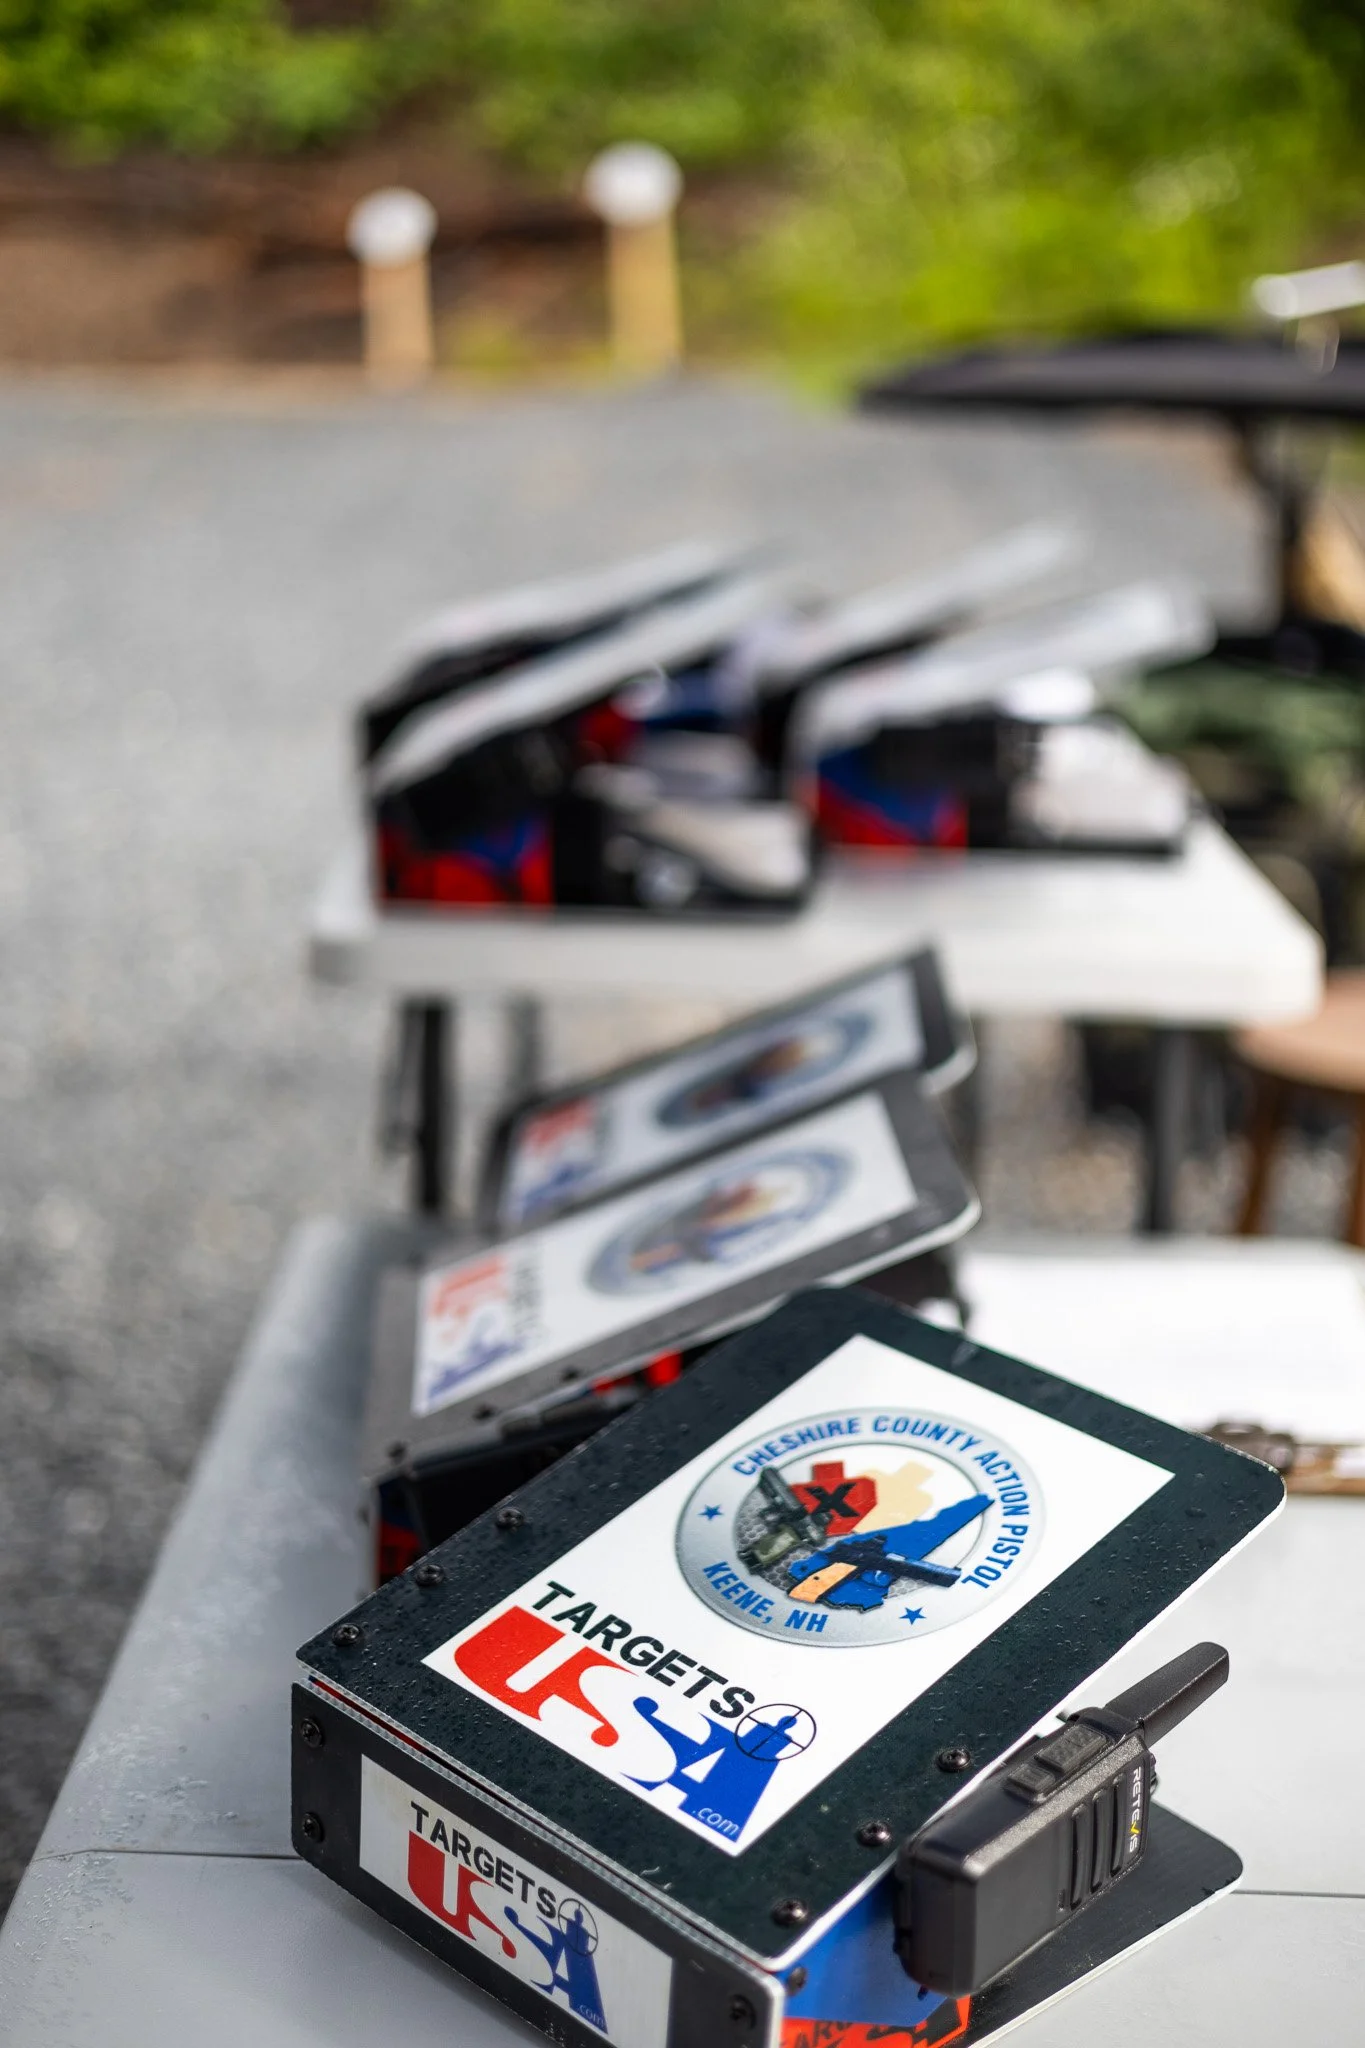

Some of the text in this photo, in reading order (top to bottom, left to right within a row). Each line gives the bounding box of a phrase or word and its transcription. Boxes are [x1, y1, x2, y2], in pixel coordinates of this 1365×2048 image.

[732, 1415, 1031, 1590] CHESHIRE COUNTY ACTION PISTOL
[532, 1581, 756, 1719] TARGETS
[702, 1560, 829, 1634] KEENE, NH
[454, 1605, 797, 1843] USA
[410, 1801, 557, 1919] TARGETS
[692, 1807, 740, 1836] .com
[1129, 1766, 1142, 1853] RETEVIS
[407, 1830, 608, 2035] USA
